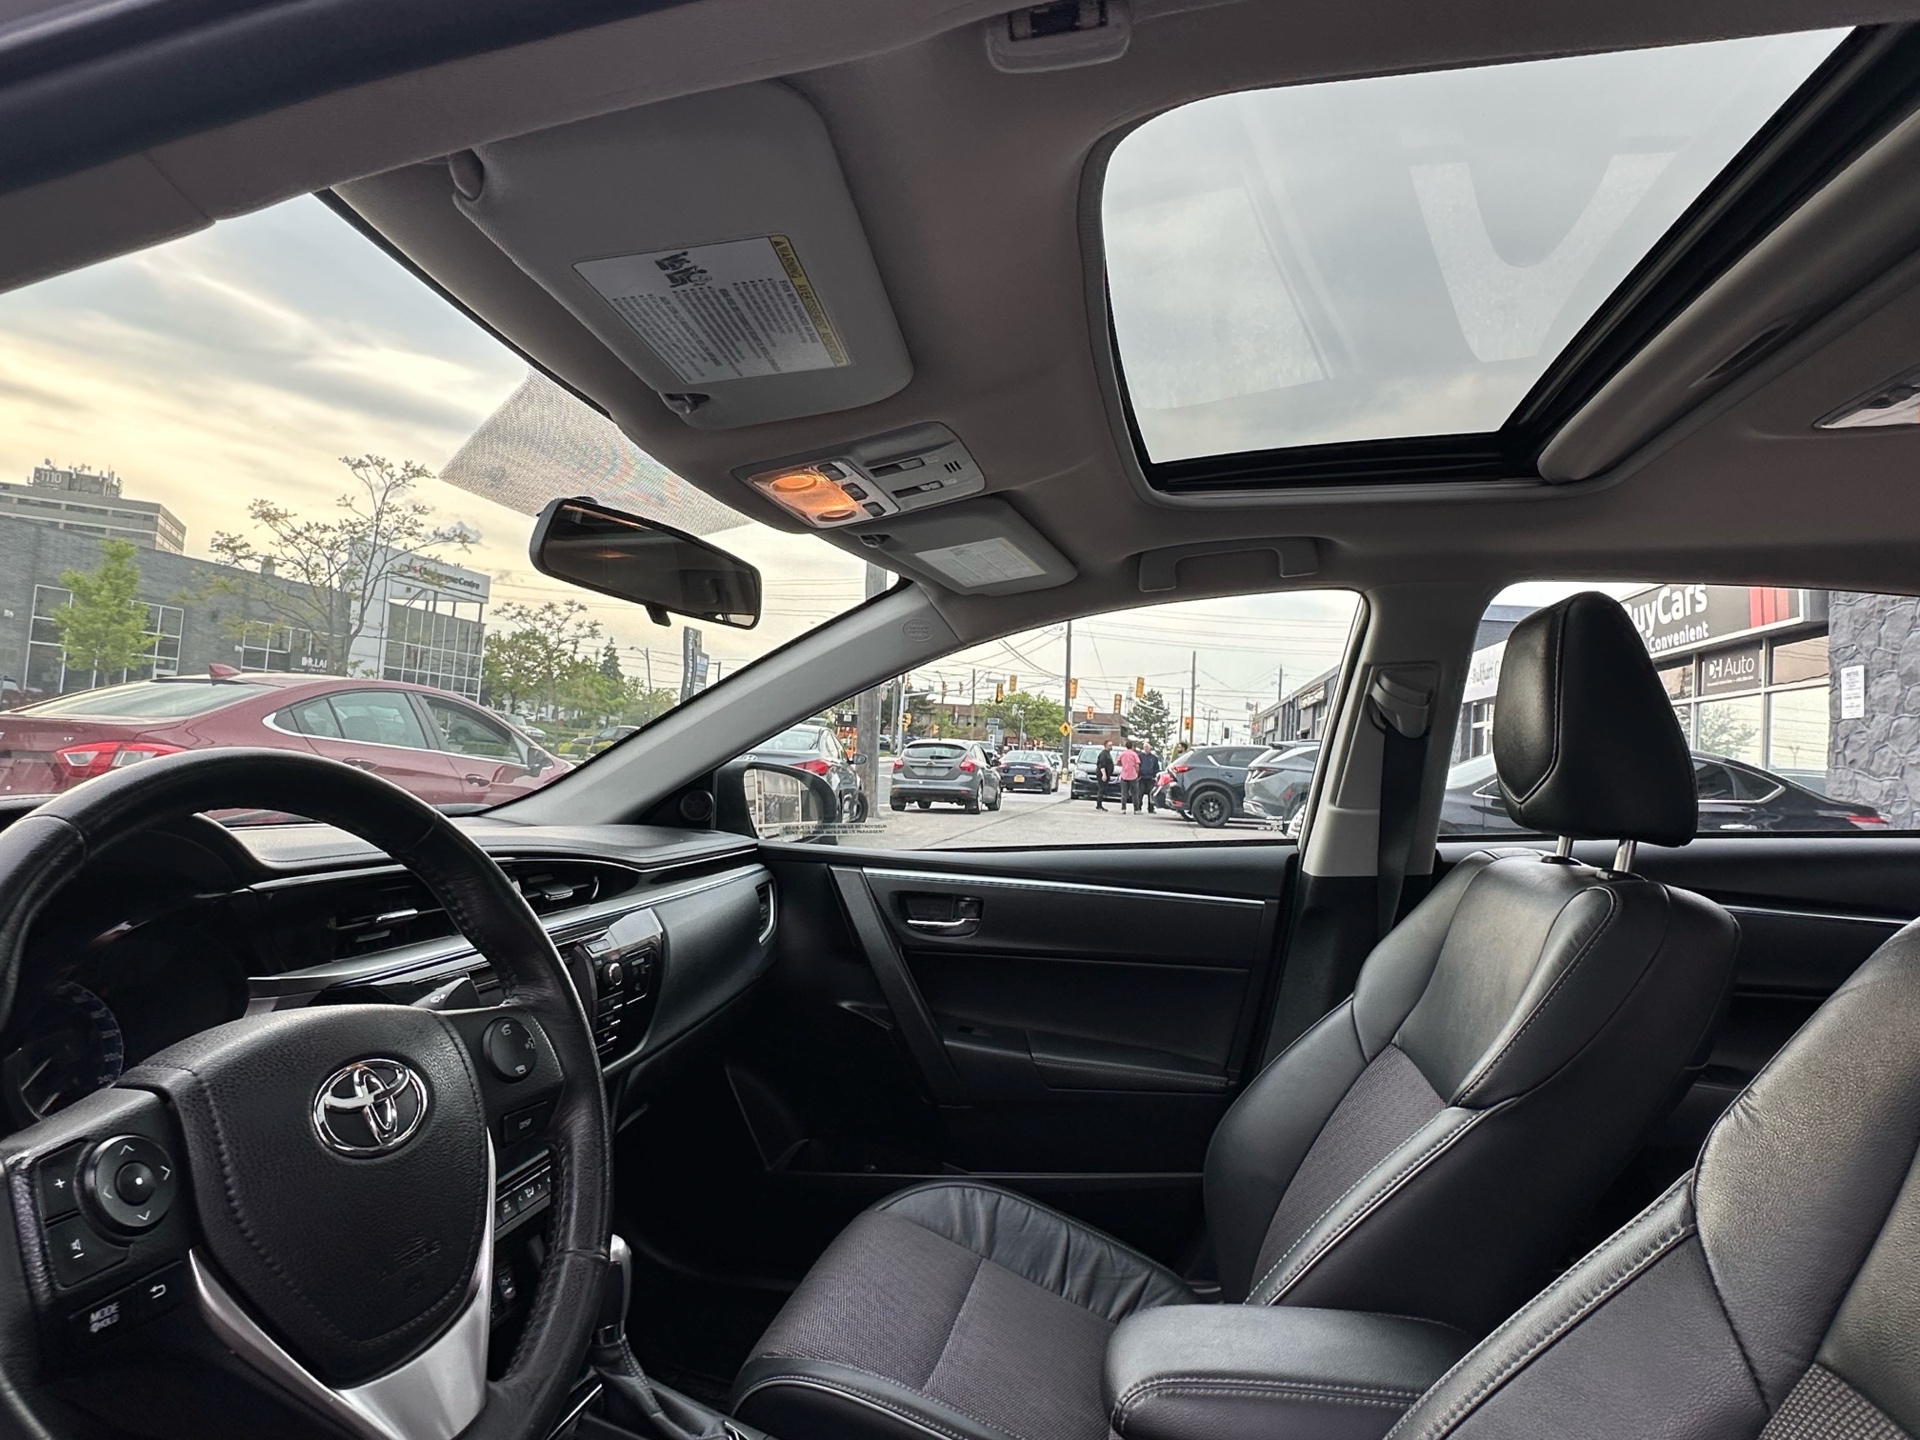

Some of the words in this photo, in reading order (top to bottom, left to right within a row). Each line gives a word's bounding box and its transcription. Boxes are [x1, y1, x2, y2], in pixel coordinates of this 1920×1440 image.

[776, 246, 802, 278] WARNING
[40, 470, 62, 484] 1110
[1650, 620, 1709, 652] Convenient
[1723, 655, 1755, 677] Auto
[90, 1301, 120, 1324] MODE
